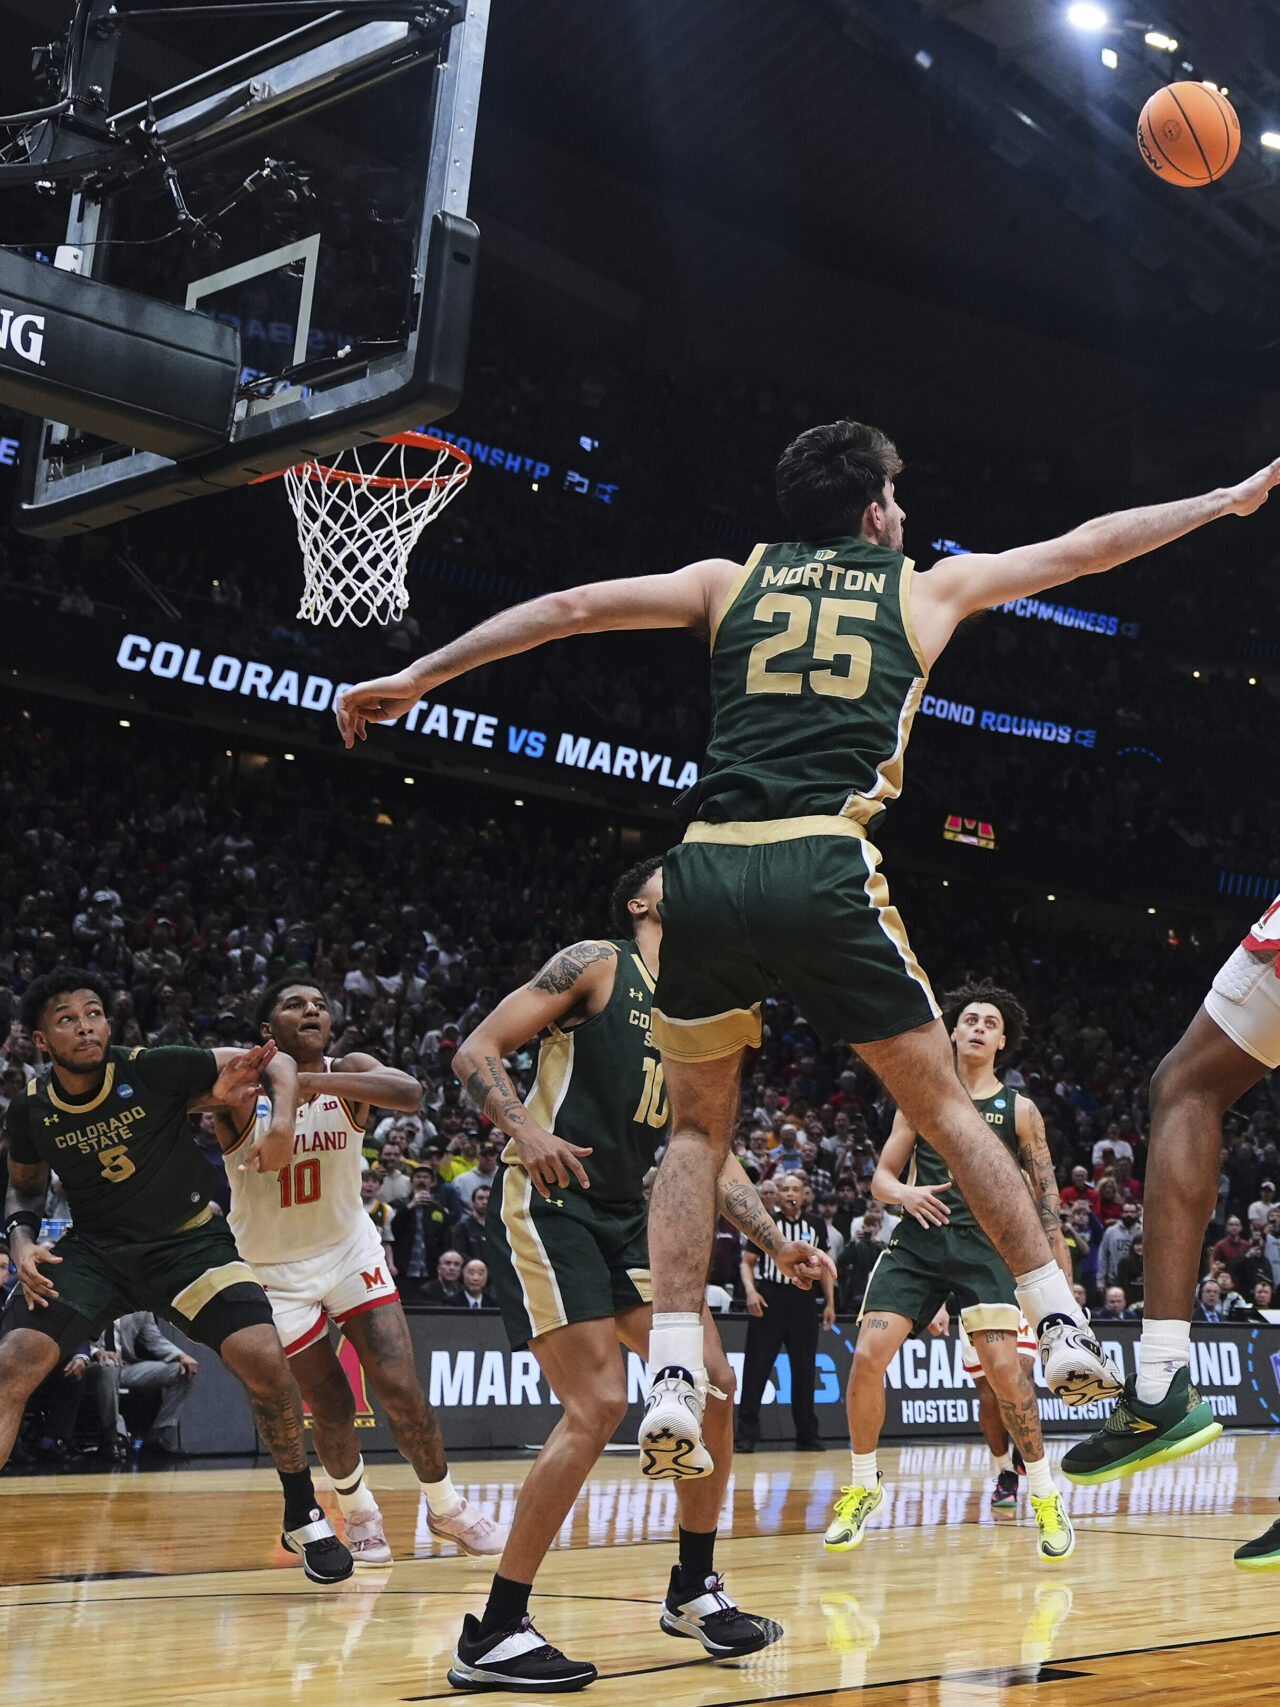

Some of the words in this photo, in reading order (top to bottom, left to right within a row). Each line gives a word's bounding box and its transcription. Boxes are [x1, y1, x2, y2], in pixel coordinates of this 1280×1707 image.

[761, 563, 887, 594] MORTON
[746, 592, 878, 700] 25
[376, 700, 499, 748] TATE
[508, 725, 547, 759] VS
[980, 711, 1071, 745] ROUNDS
[633, 1056, 669, 1129] 10
[55, 1106, 147, 1150] COLORADO
[78, 1126, 133, 1154] STATE
[98, 1145, 136, 1183] 5
[277, 1158, 321, 1208] 10
[867, 1318, 889, 1330] 1969
[902, 1399, 969, 1424] HOSTED
